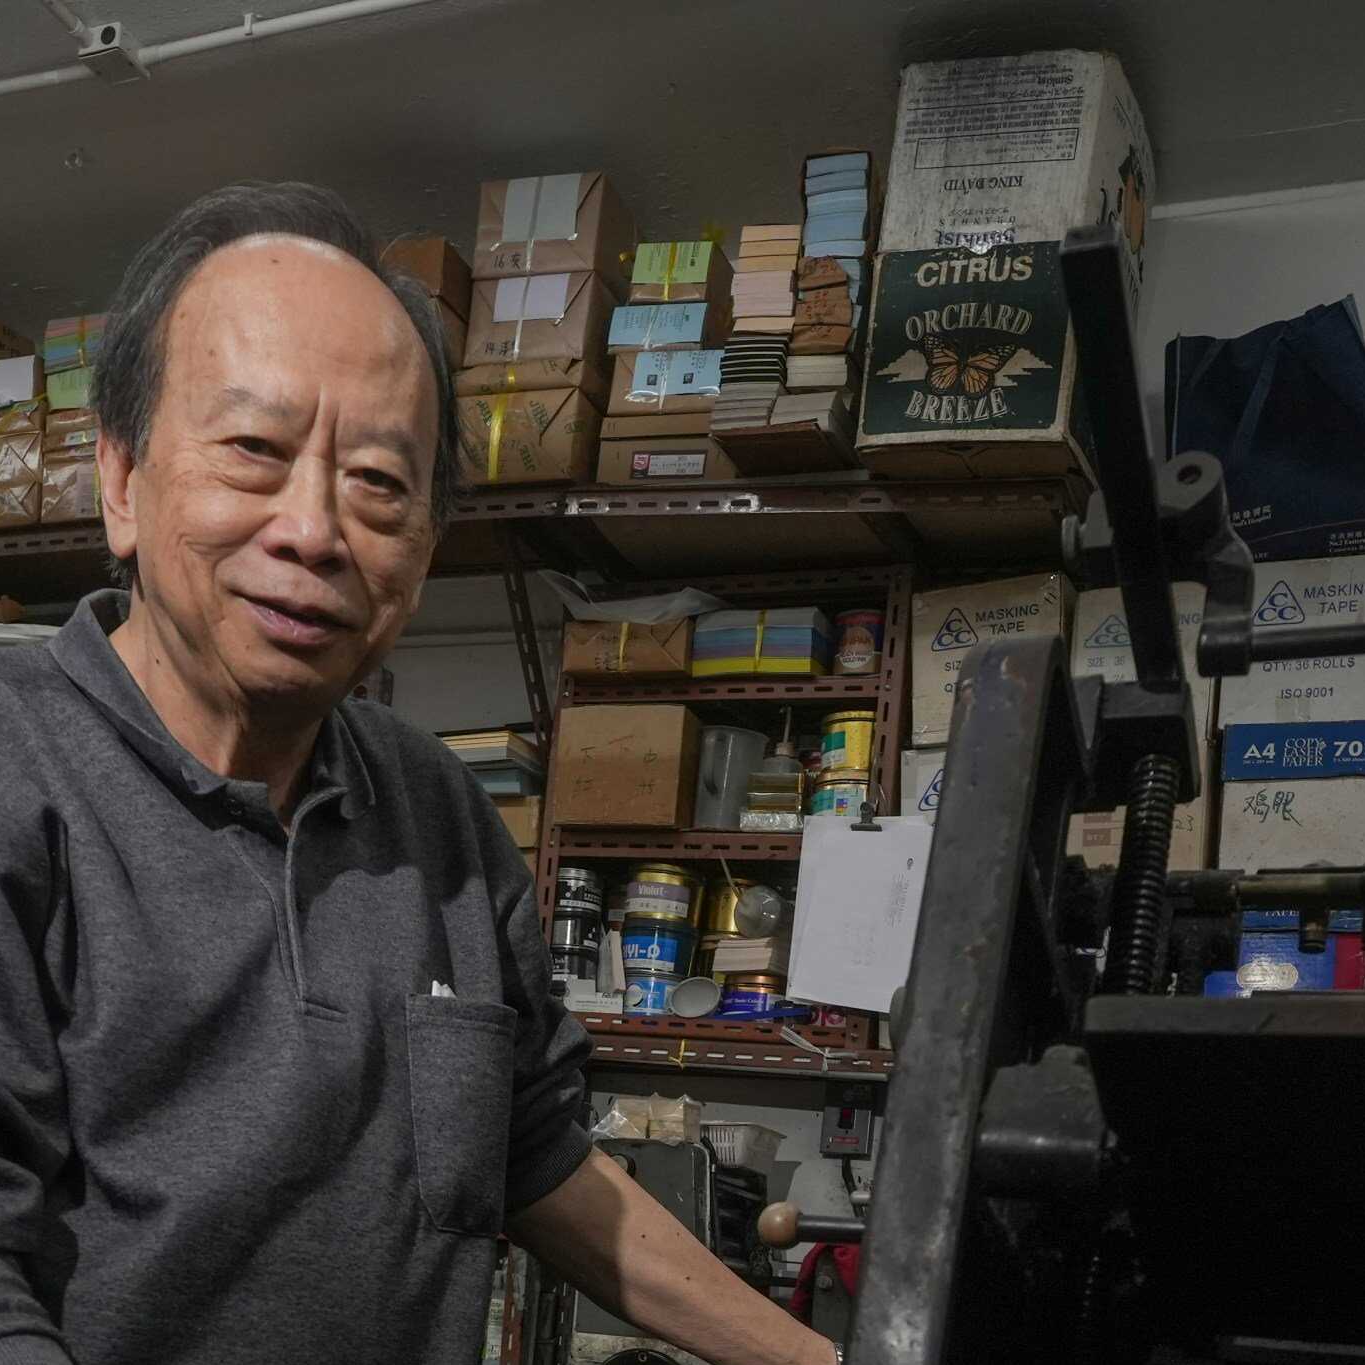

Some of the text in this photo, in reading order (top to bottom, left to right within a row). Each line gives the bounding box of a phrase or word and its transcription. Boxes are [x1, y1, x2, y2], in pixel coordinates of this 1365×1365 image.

[944, 175, 1023, 193] KING DAVID
[916, 255, 1034, 288] CITRUS
[905, 302, 1034, 342] ORCHARD
[904, 386, 1009, 424] BREEZE
[975, 603, 1040, 623] MASKING
[1319, 600, 1358, 614] TAPE
[990, 620, 1026, 635] TAPE
[944, 660, 962, 671] SIZ
[1262, 661, 1292, 672] QTY:
[1313, 656, 1356, 669] ROLLS
[1281, 687, 1334, 699] ISO 9001
[1243, 742, 1276, 760] A4
[1285, 737, 1324, 750] COPY
[1333, 740, 1364, 758] 70
[1283, 748, 1324, 759] LASER
[1282, 757, 1324, 768] PAPER
